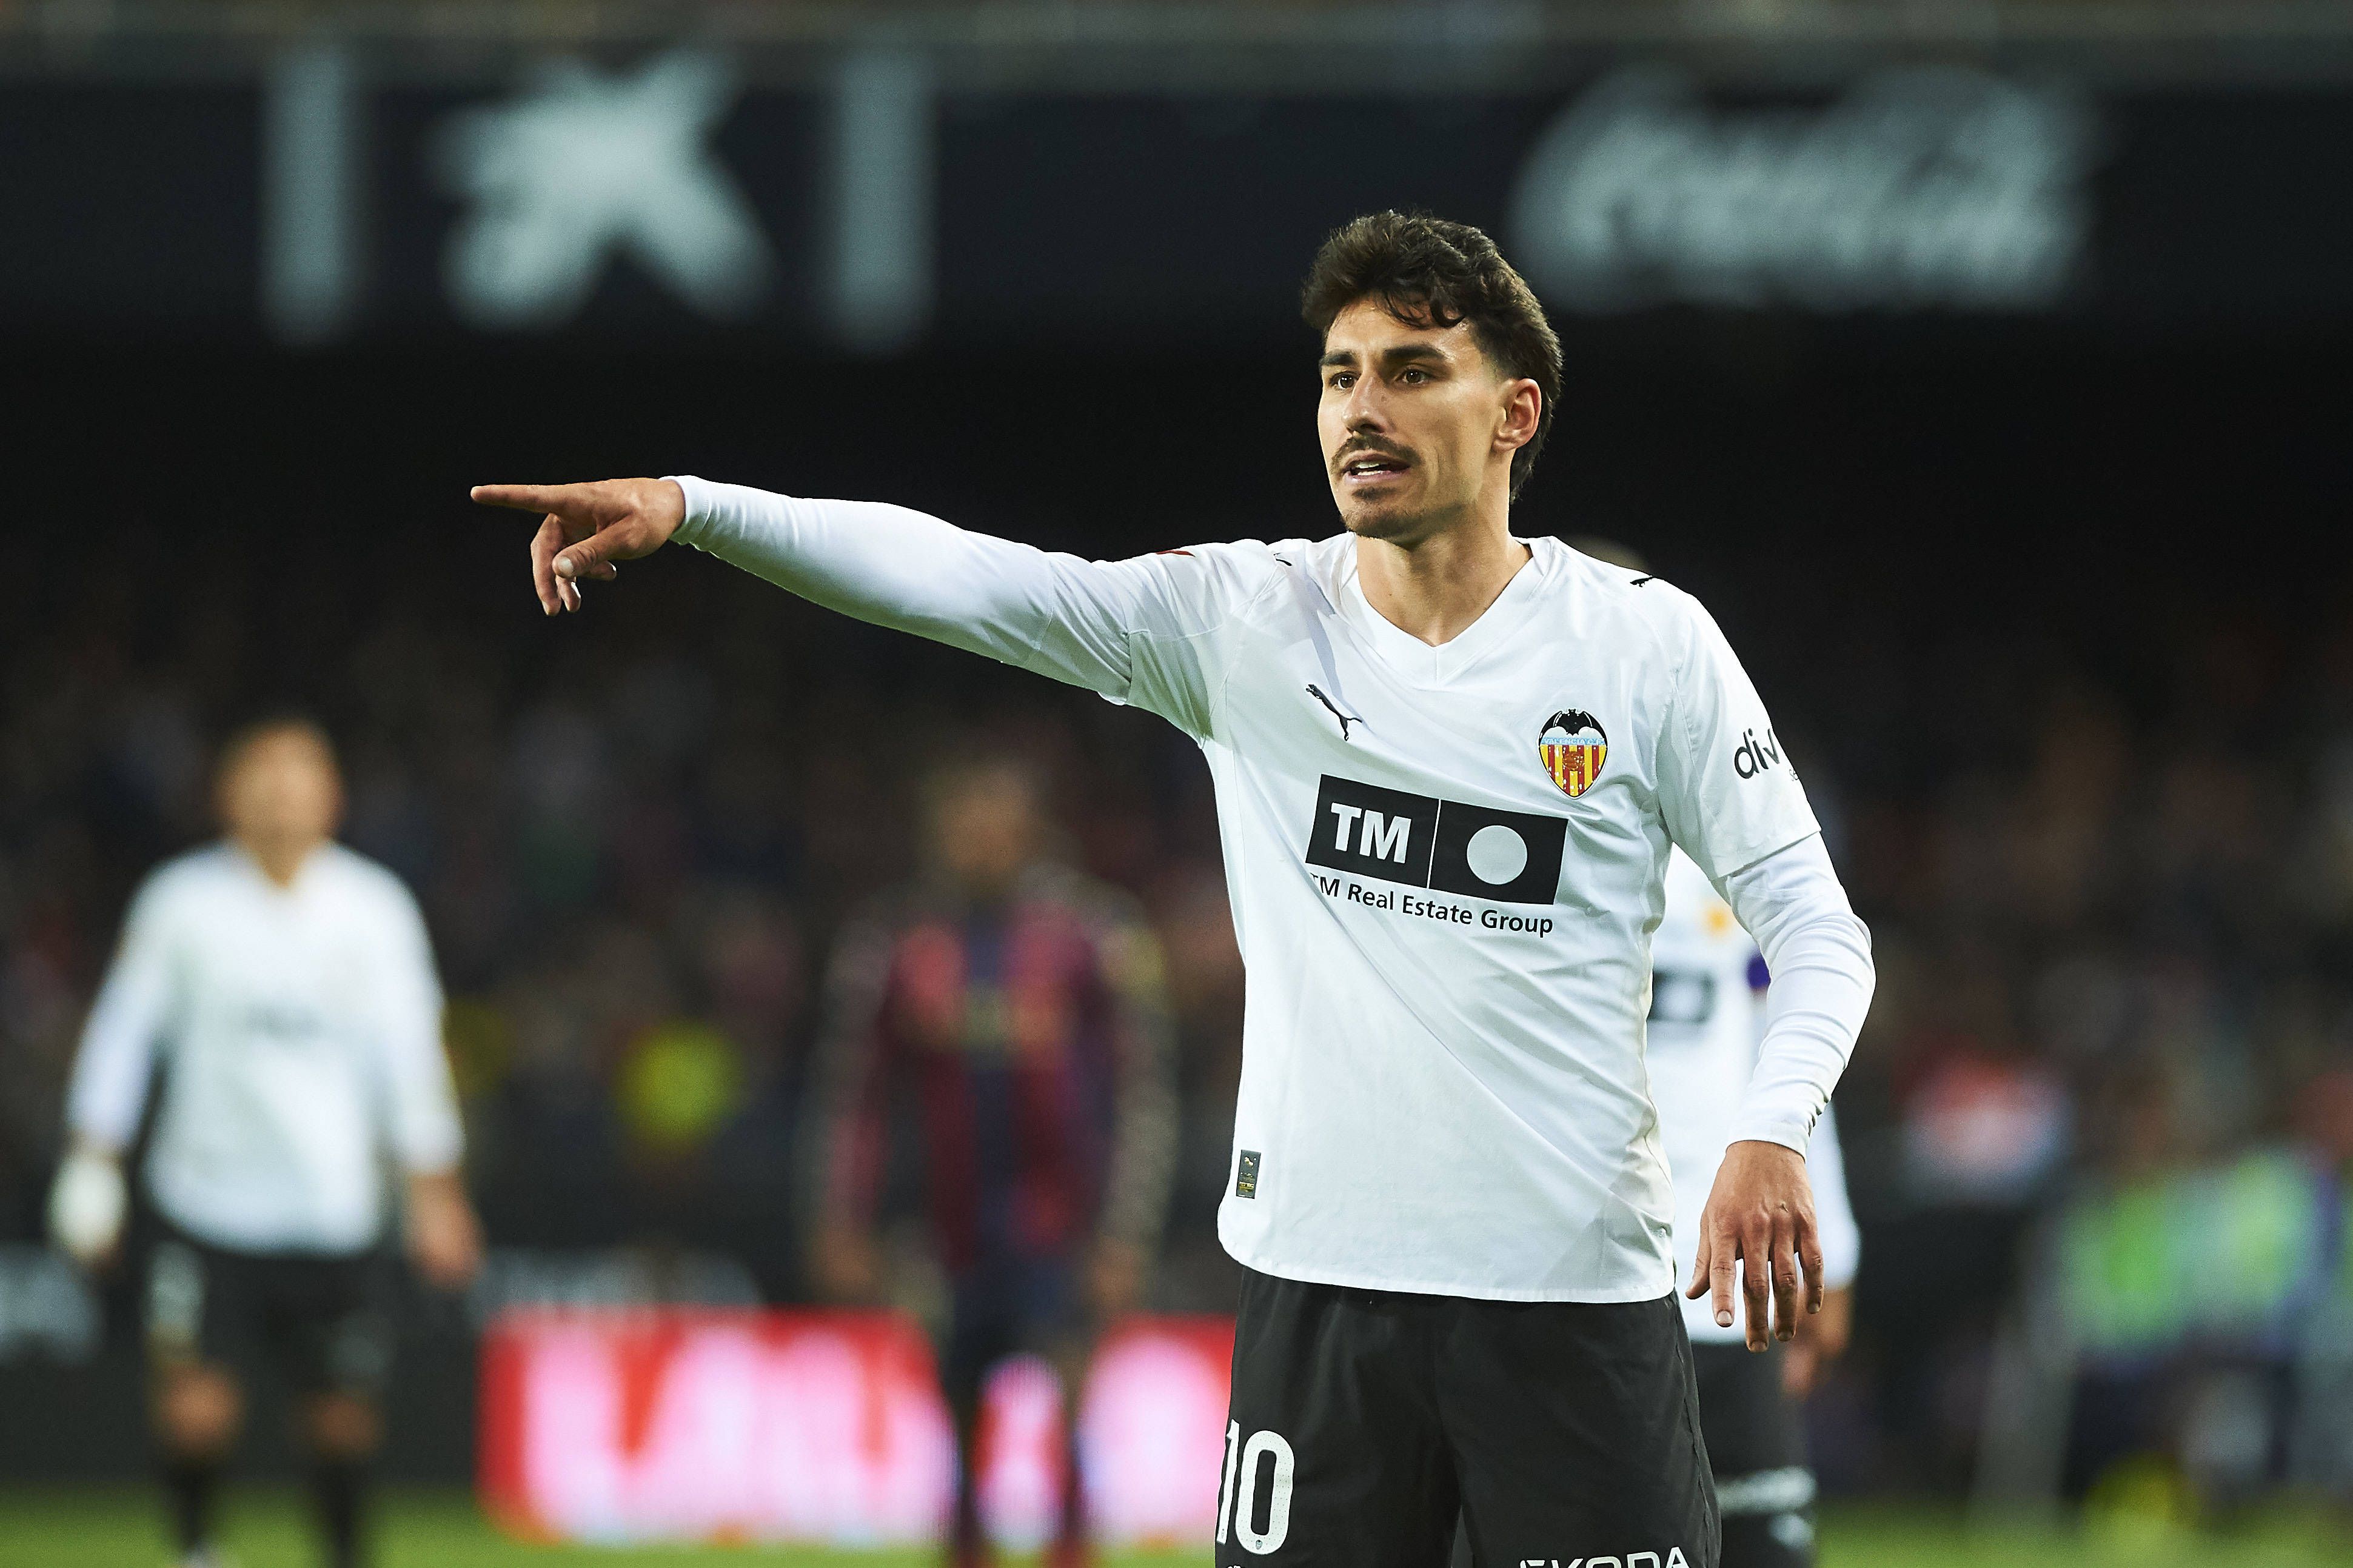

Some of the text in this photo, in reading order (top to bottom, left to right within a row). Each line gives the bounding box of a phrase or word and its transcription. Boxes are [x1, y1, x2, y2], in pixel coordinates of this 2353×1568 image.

[1330, 802, 1412, 864] TM
[1347, 883, 1394, 910] Real
[1402, 895, 1473, 925] Estate
[1481, 909, 1553, 938] Group
[1216, 1418, 1295, 1555] 10
